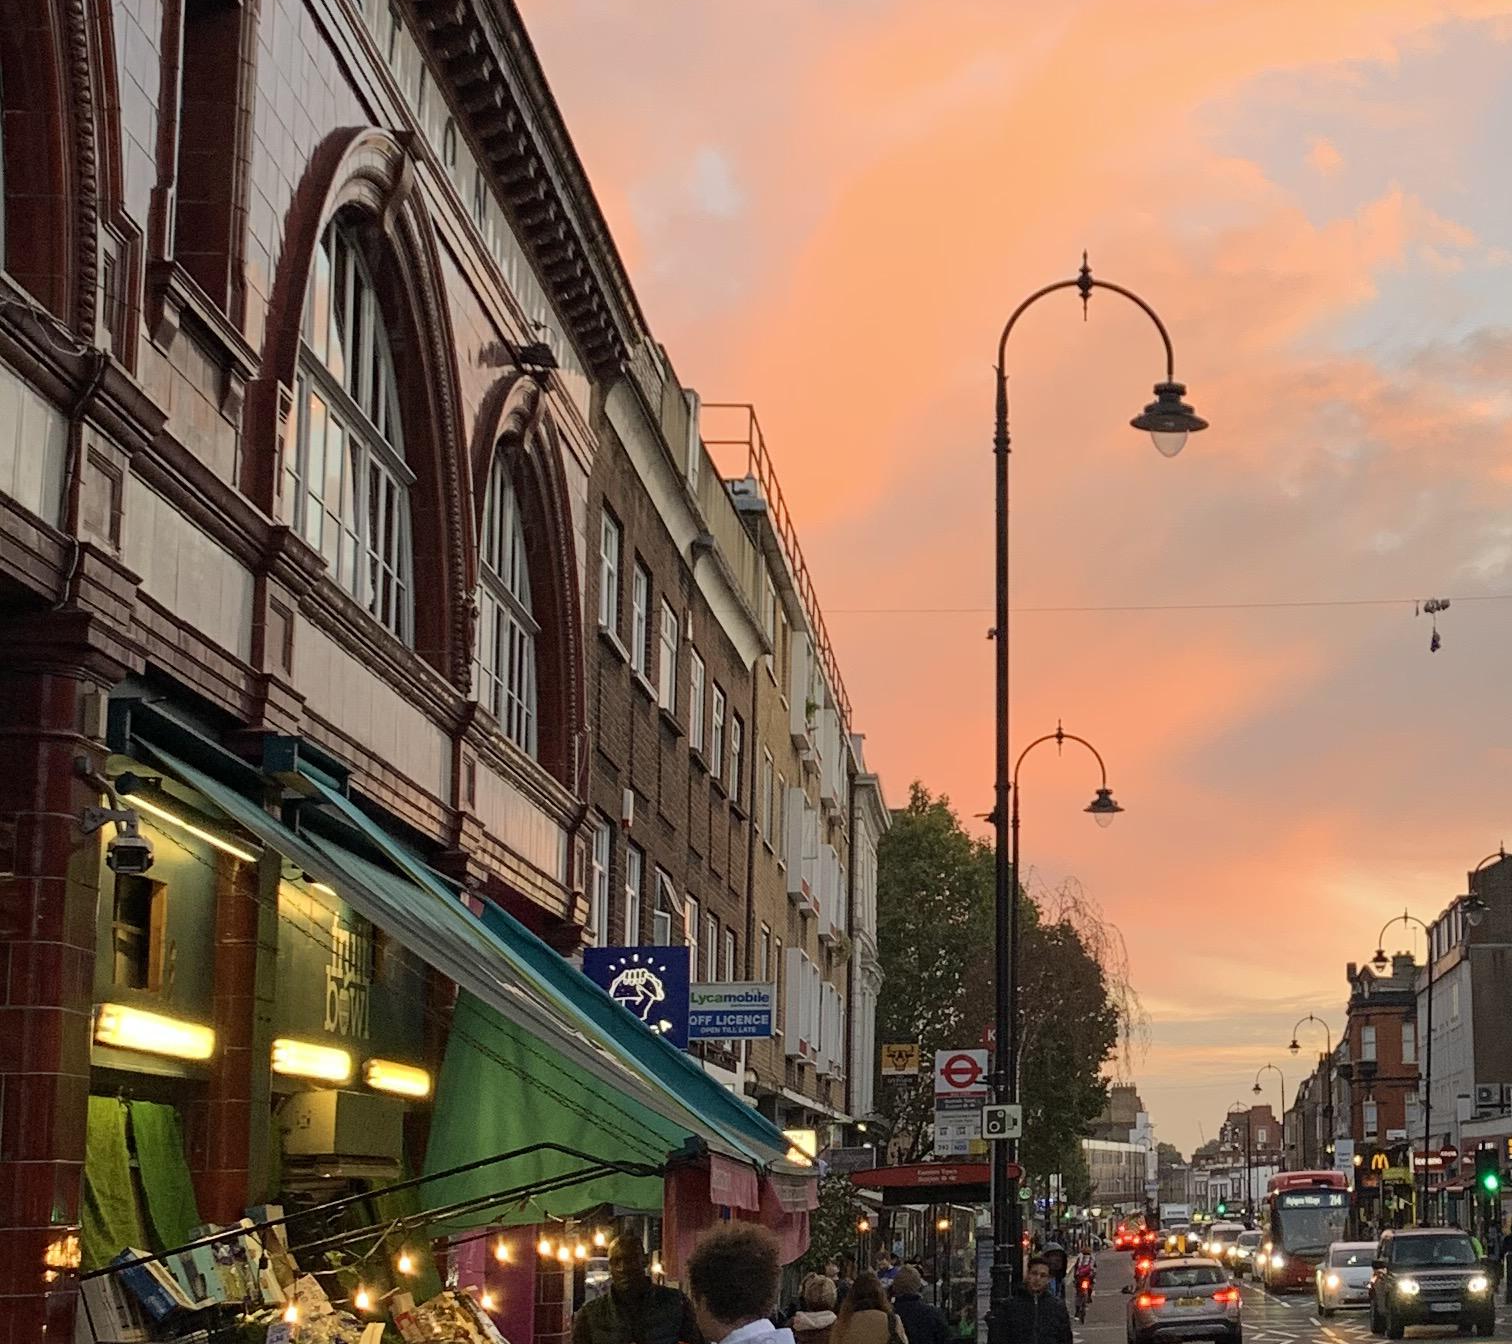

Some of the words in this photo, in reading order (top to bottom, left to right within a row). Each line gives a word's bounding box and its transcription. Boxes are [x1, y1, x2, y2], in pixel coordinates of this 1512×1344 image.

[690, 991, 770, 1005] Lycamobile
[688, 1014, 712, 1026] OFF
[715, 1014, 769, 1026] LICENCE
